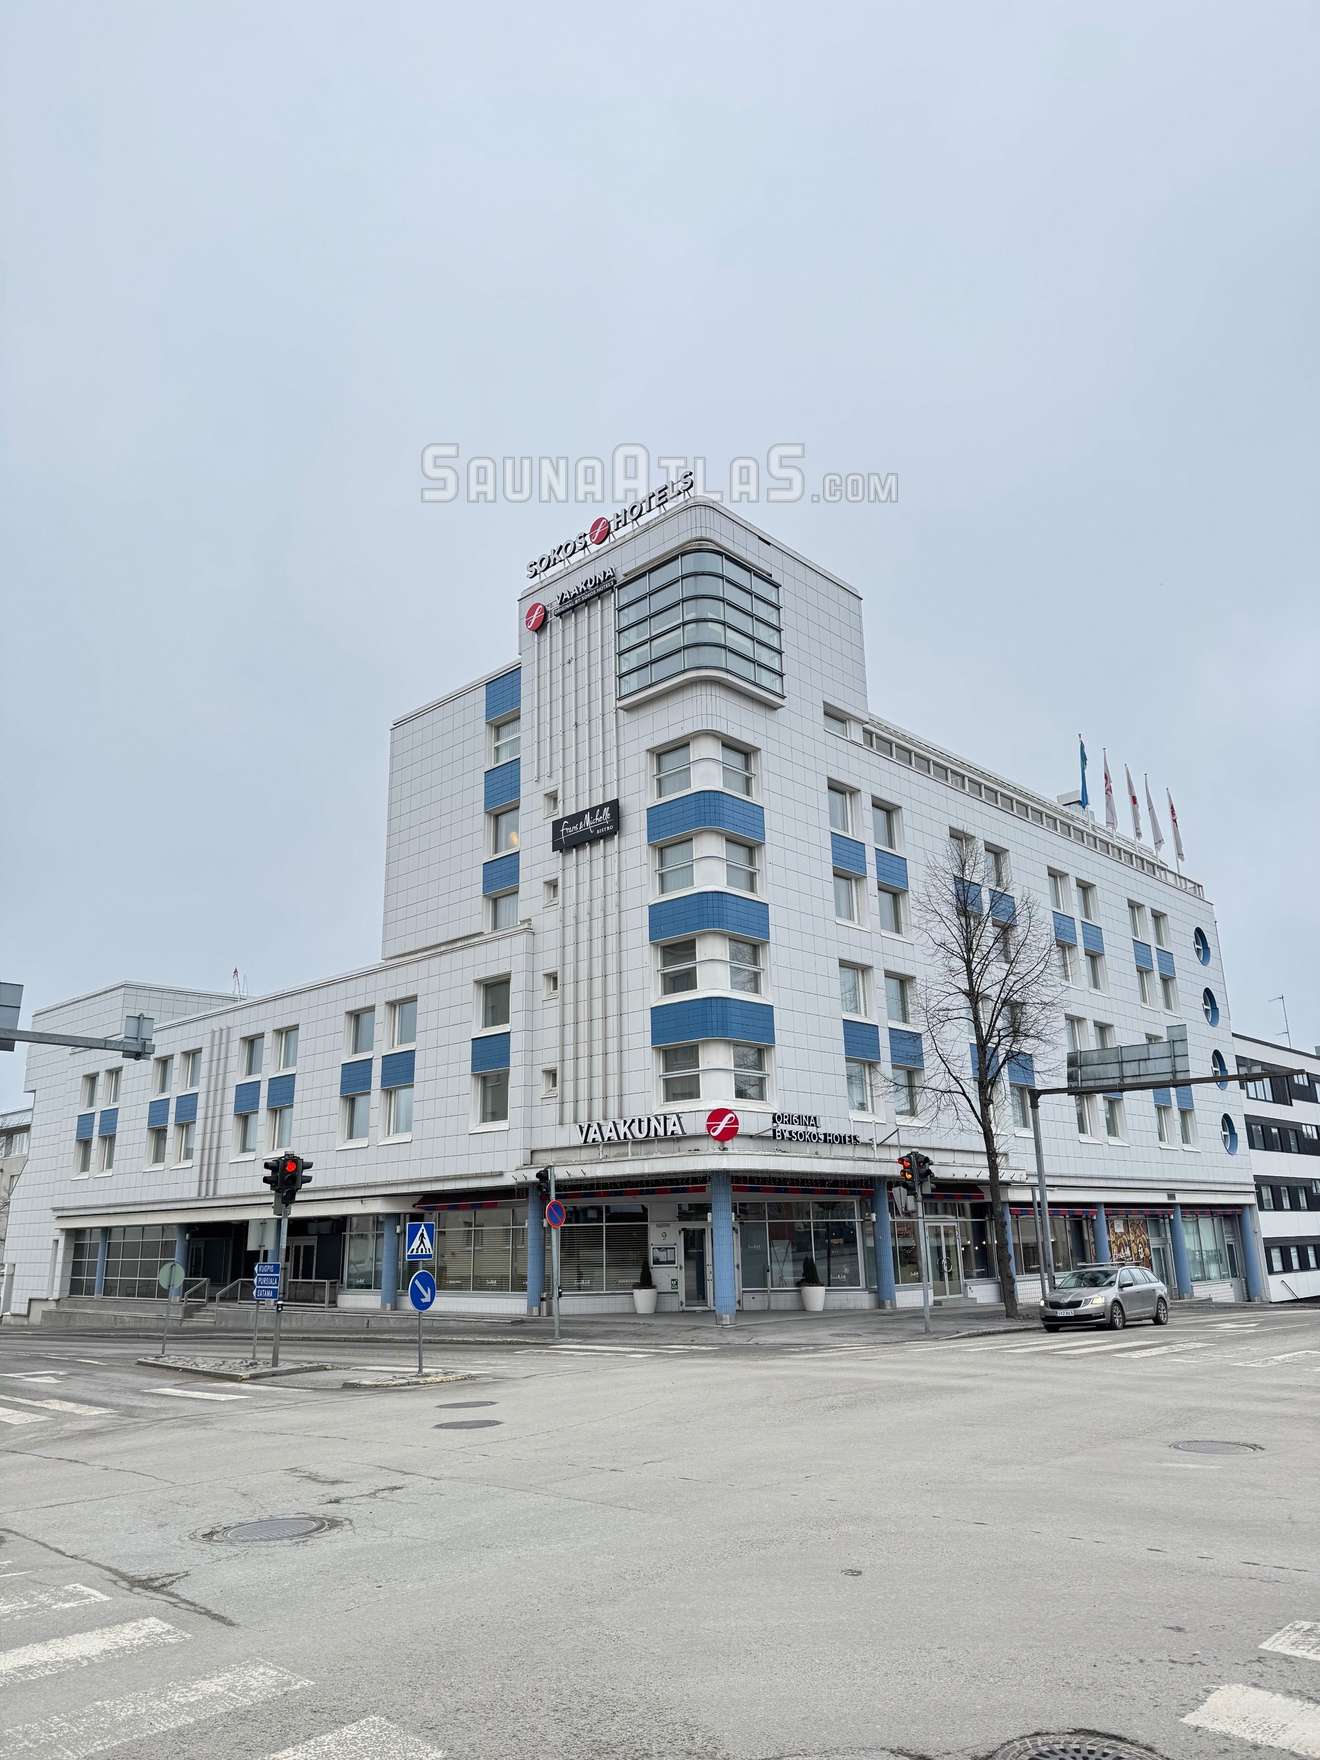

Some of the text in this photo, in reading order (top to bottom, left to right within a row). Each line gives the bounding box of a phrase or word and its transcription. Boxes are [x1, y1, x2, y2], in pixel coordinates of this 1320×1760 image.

[526, 471, 694, 579] SOKOS HOTELS
[556, 567, 616, 605] VAAKUNA
[596, 825, 614, 834] BISTRO
[576, 1114, 686, 1144] VAAKUNA
[775, 1112, 820, 1127] ORIGINAL
[775, 1128, 860, 1145] BY SOKOS HOTELS
